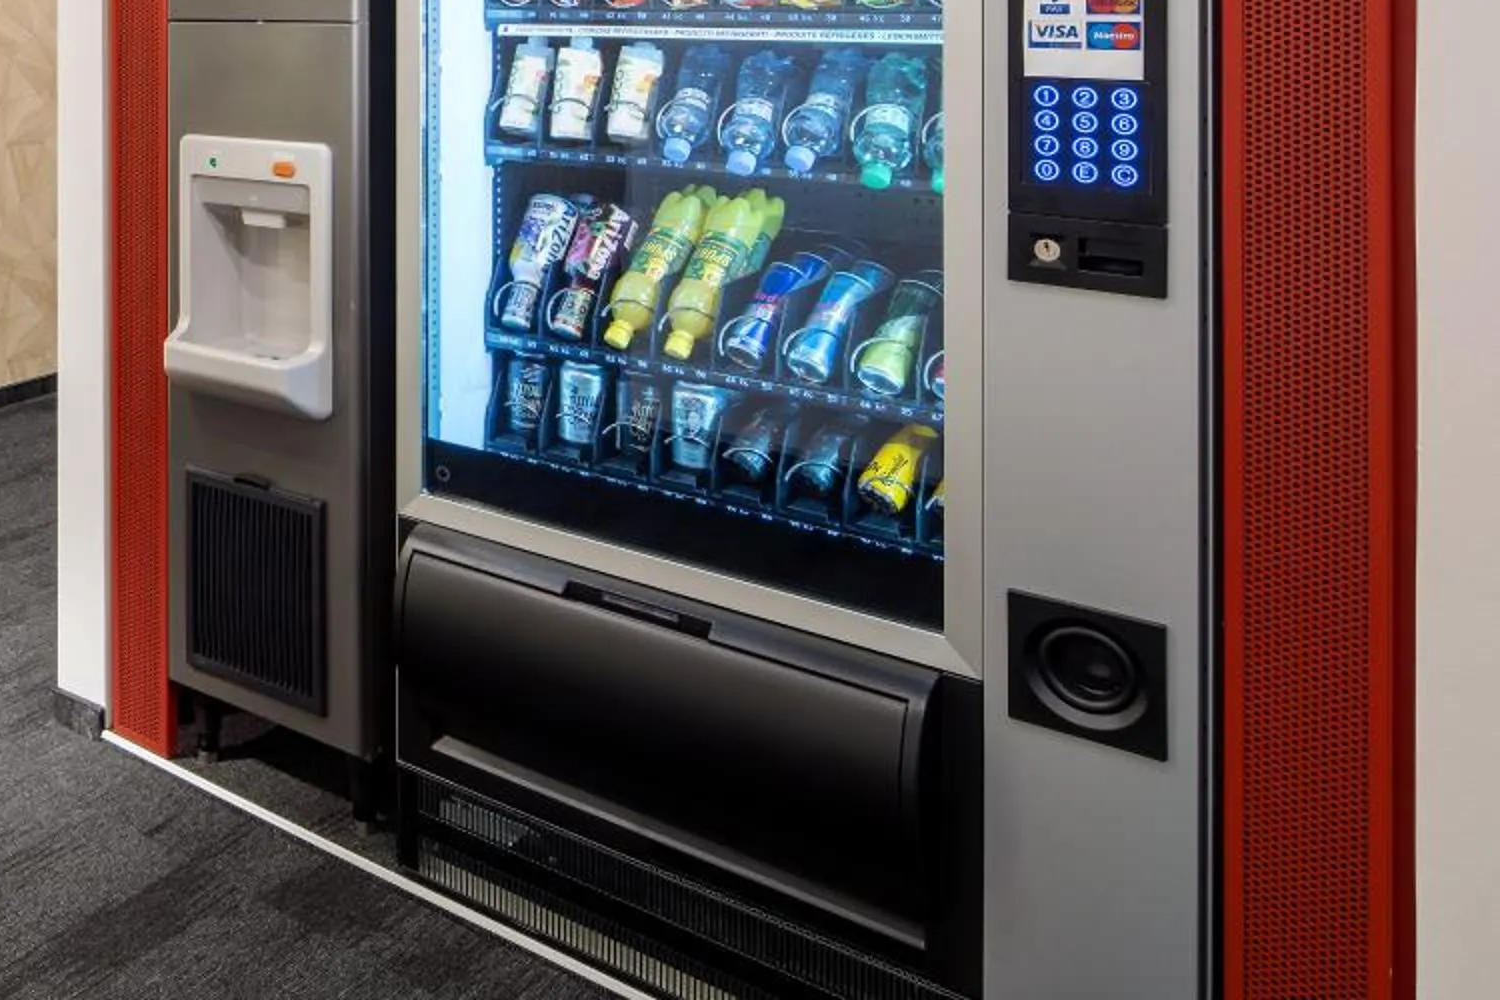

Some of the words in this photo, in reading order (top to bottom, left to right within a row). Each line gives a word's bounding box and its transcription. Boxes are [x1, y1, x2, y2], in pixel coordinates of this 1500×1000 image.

[1035, 24, 1078, 38] VISA
[1093, 31, 1135, 40] Maestro
[1043, 90, 1049, 102] 1
[1079, 91, 1090, 104] 2
[1119, 93, 1129, 105] 3
[1041, 115, 1051, 126] 4
[1079, 115, 1090, 128] 5
[1119, 117, 1130, 130] 6
[1041, 139, 1051, 151] 7
[1080, 141, 1090, 153] 8
[1119, 143, 1130, 156] 9
[1041, 164, 1052, 176] 0
[1080, 166, 1090, 179] E
[1117, 169, 1131, 181] C
